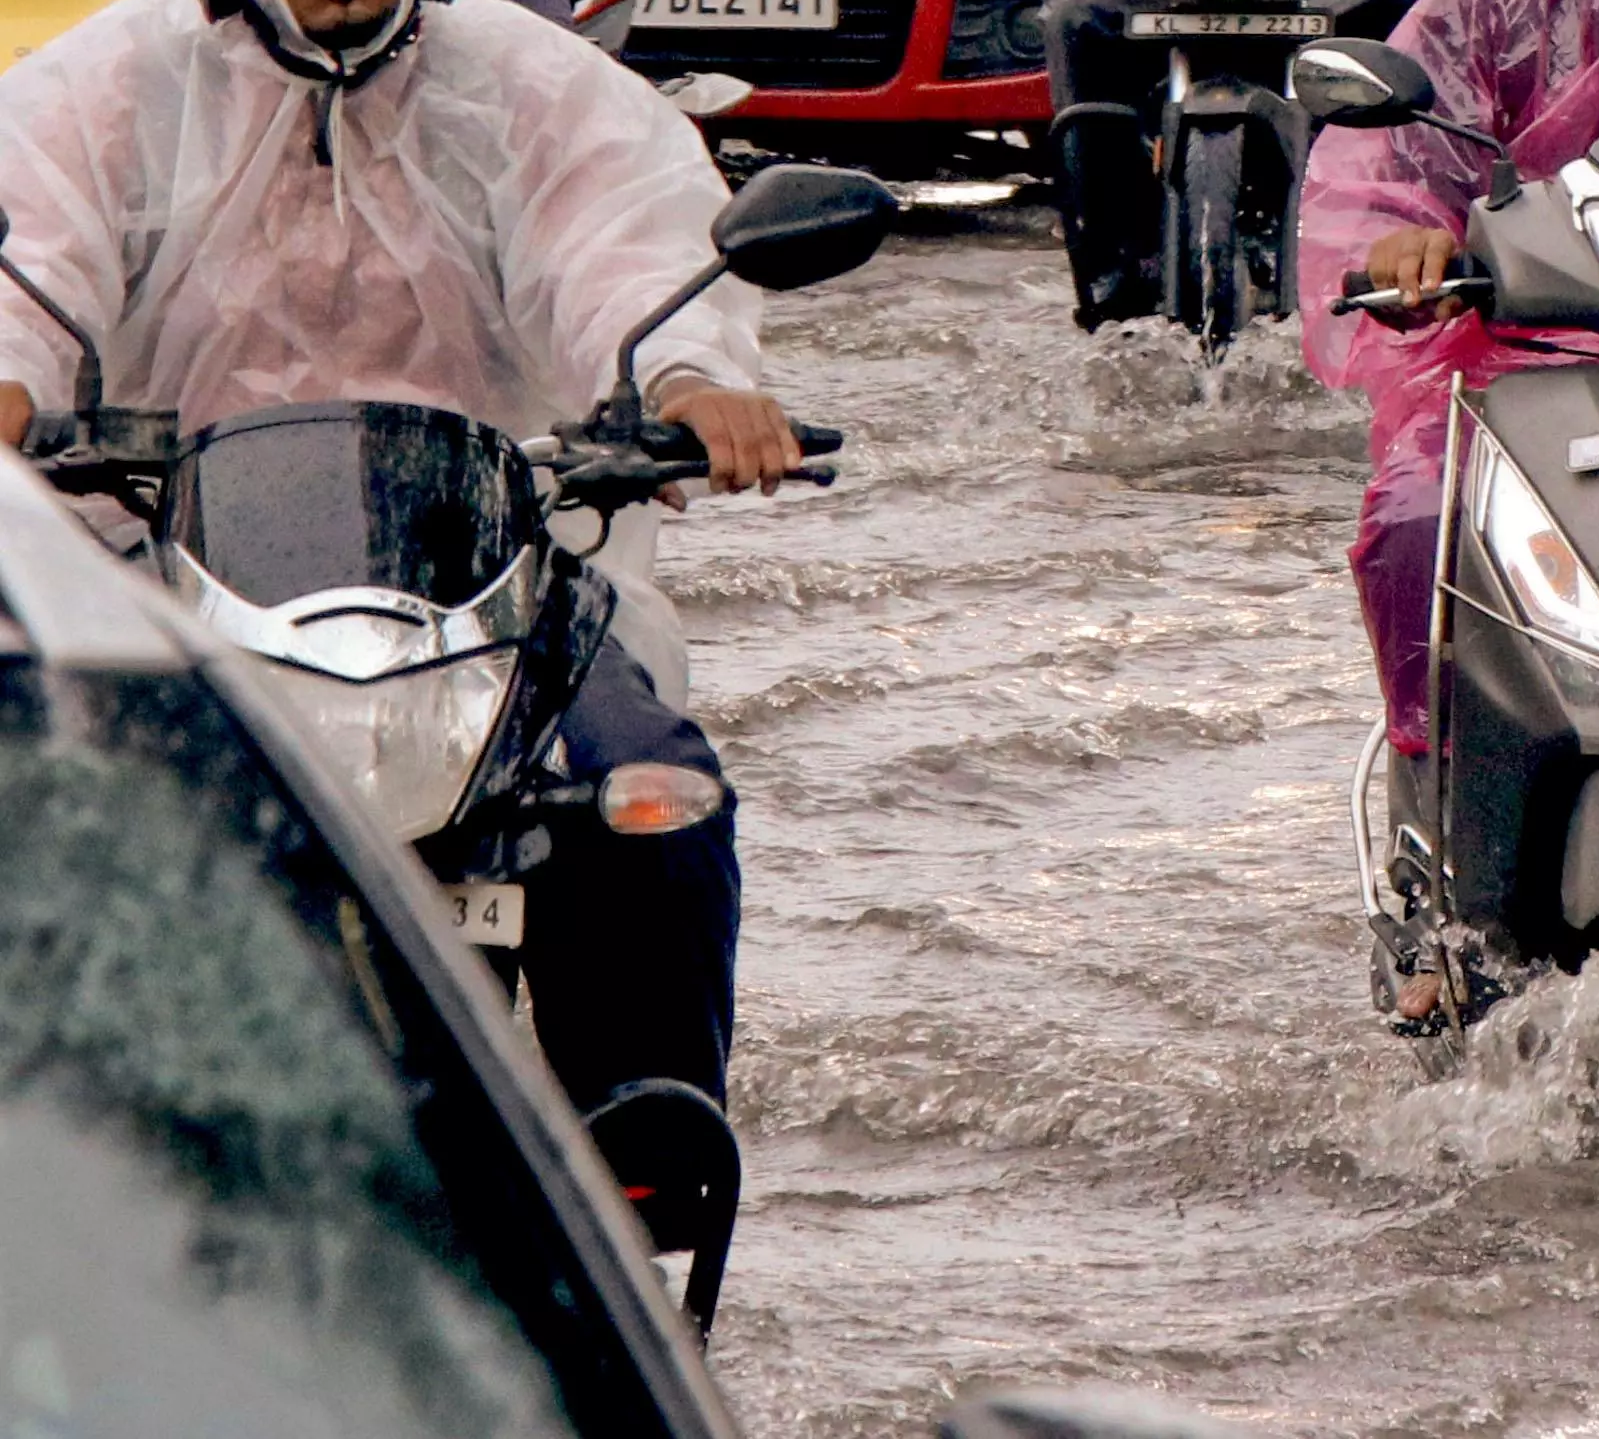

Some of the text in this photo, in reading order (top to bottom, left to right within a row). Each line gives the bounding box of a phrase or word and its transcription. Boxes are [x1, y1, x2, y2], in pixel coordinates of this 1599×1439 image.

[1153, 16, 1181, 33] KL
[1199, 16, 1227, 33] 32
[1265, 16, 1323, 34] 2213
